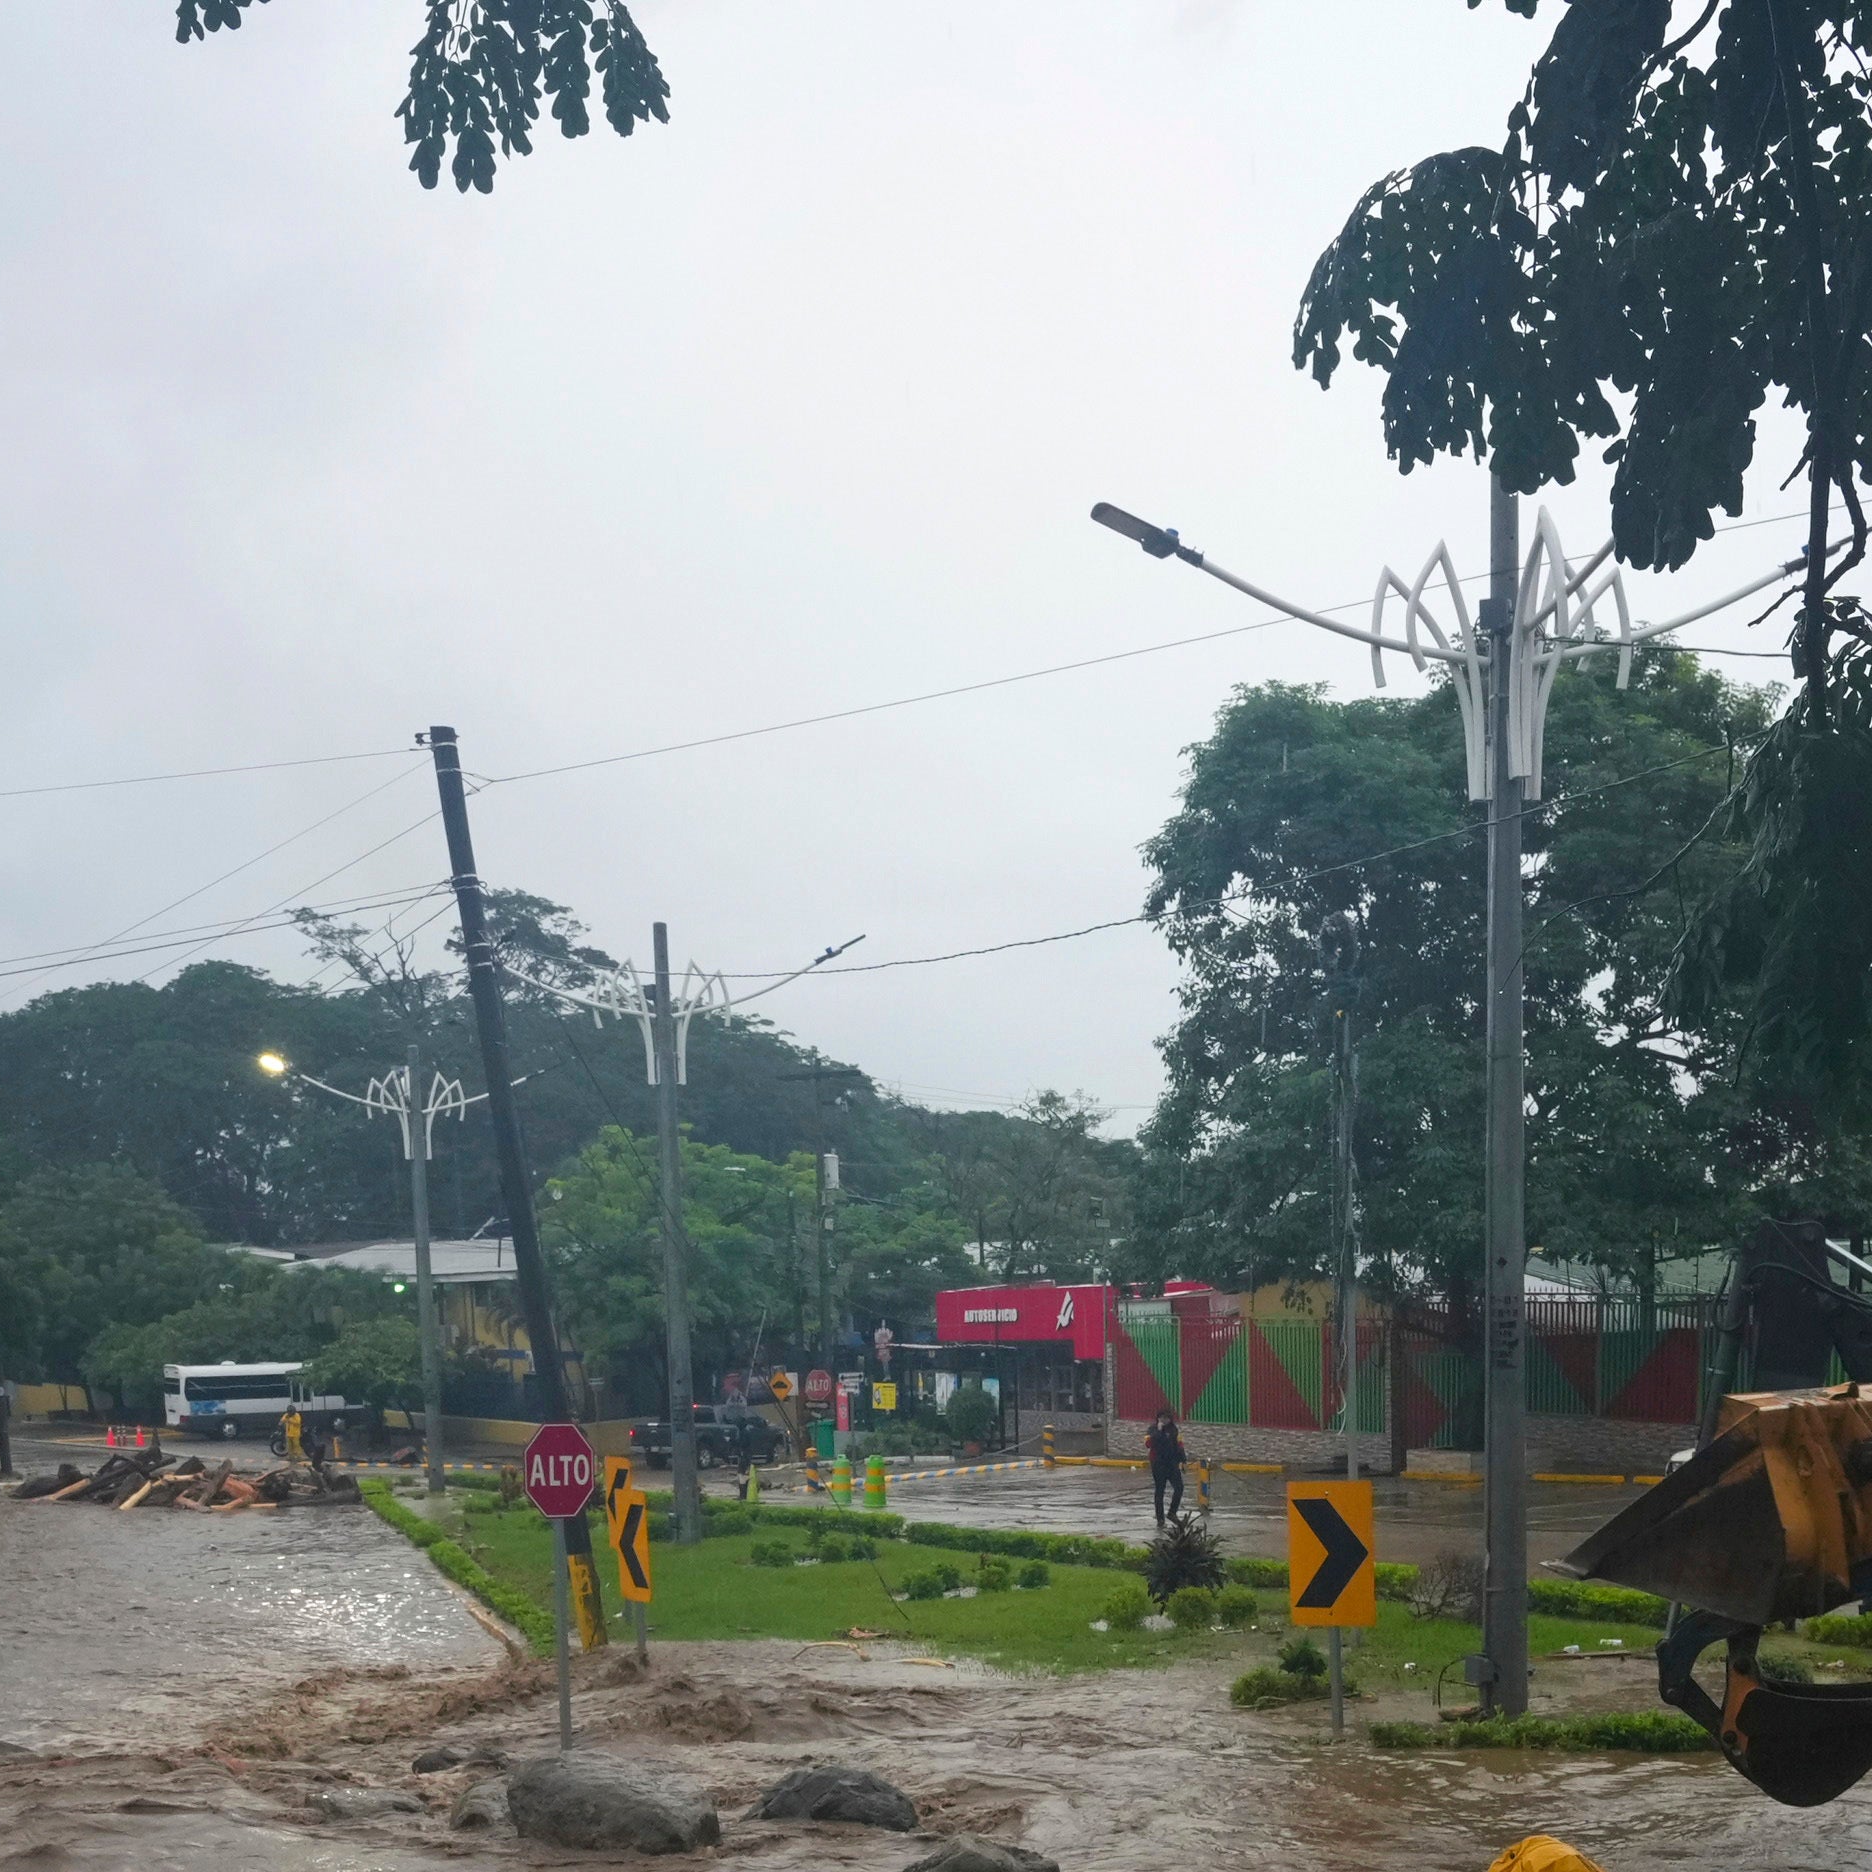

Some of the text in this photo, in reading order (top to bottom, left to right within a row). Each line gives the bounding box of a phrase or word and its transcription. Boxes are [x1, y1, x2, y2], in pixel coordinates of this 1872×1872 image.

[964, 1308, 1018, 1323] AUTOSERVICIO
[808, 1379, 829, 1392] ALTO
[530, 1454, 590, 1487] ALTO
